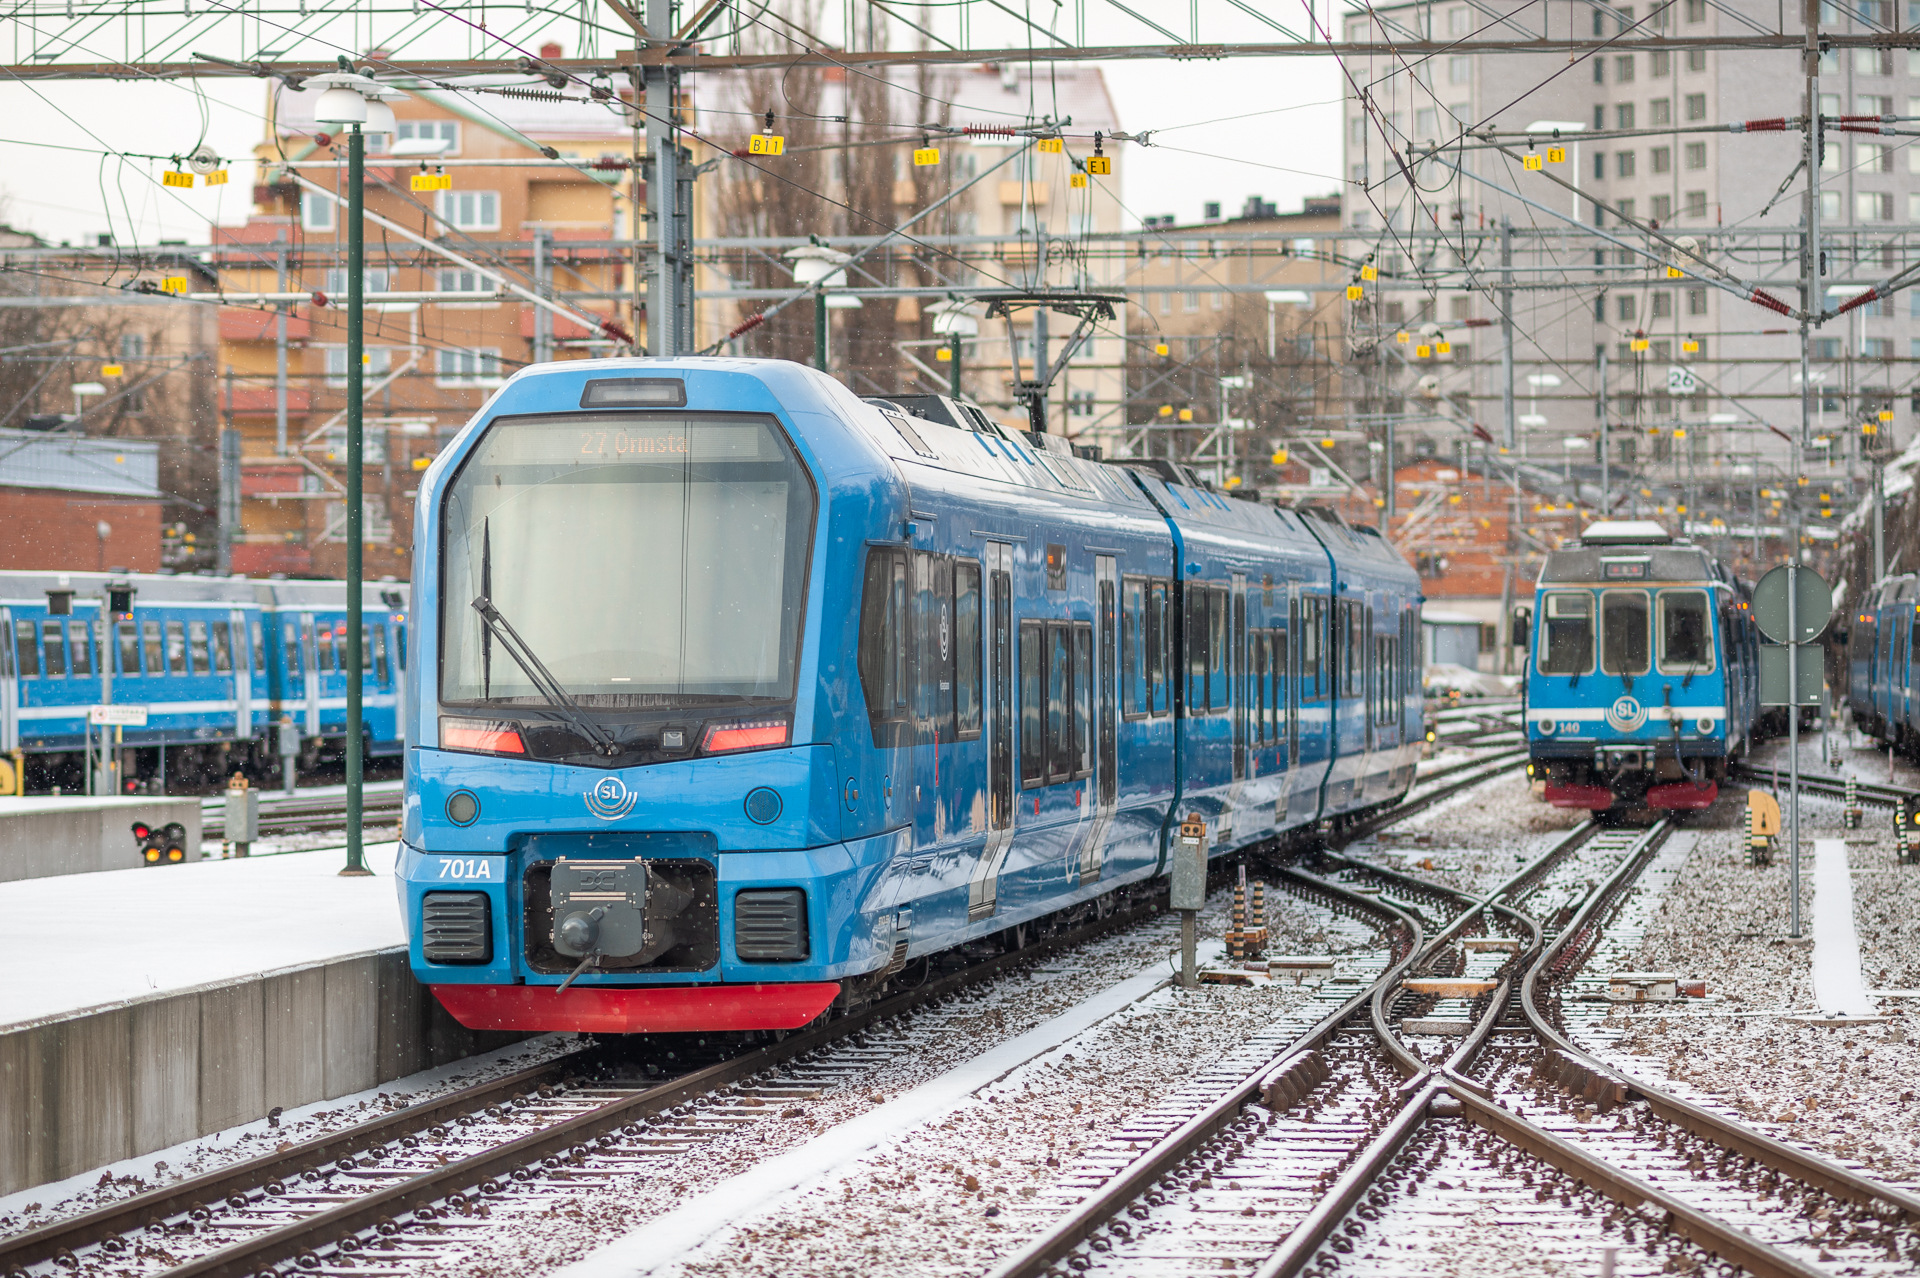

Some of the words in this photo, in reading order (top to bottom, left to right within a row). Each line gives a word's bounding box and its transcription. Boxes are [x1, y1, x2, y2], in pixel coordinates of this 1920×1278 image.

[753, 139, 778, 153] B11
[1040, 141, 1060, 152] B11
[917, 152, 936, 164] B11
[1550, 150, 1562, 162] E1
[1090, 160, 1106, 173] E1
[1526, 158, 1538, 169] E1
[165, 174, 192, 187] A113
[207, 172, 226, 185] A11
[1072, 176, 1084, 187] B1
[1670, 371, 1694, 388] 26
[581, 432, 607, 454] 27
[615, 432, 689, 453] Ormsta
[1617, 702, 1636, 718] SL
[1559, 722, 1580, 734] 140
[600, 785, 620, 800] SL
[438, 859, 491, 879] 701A
